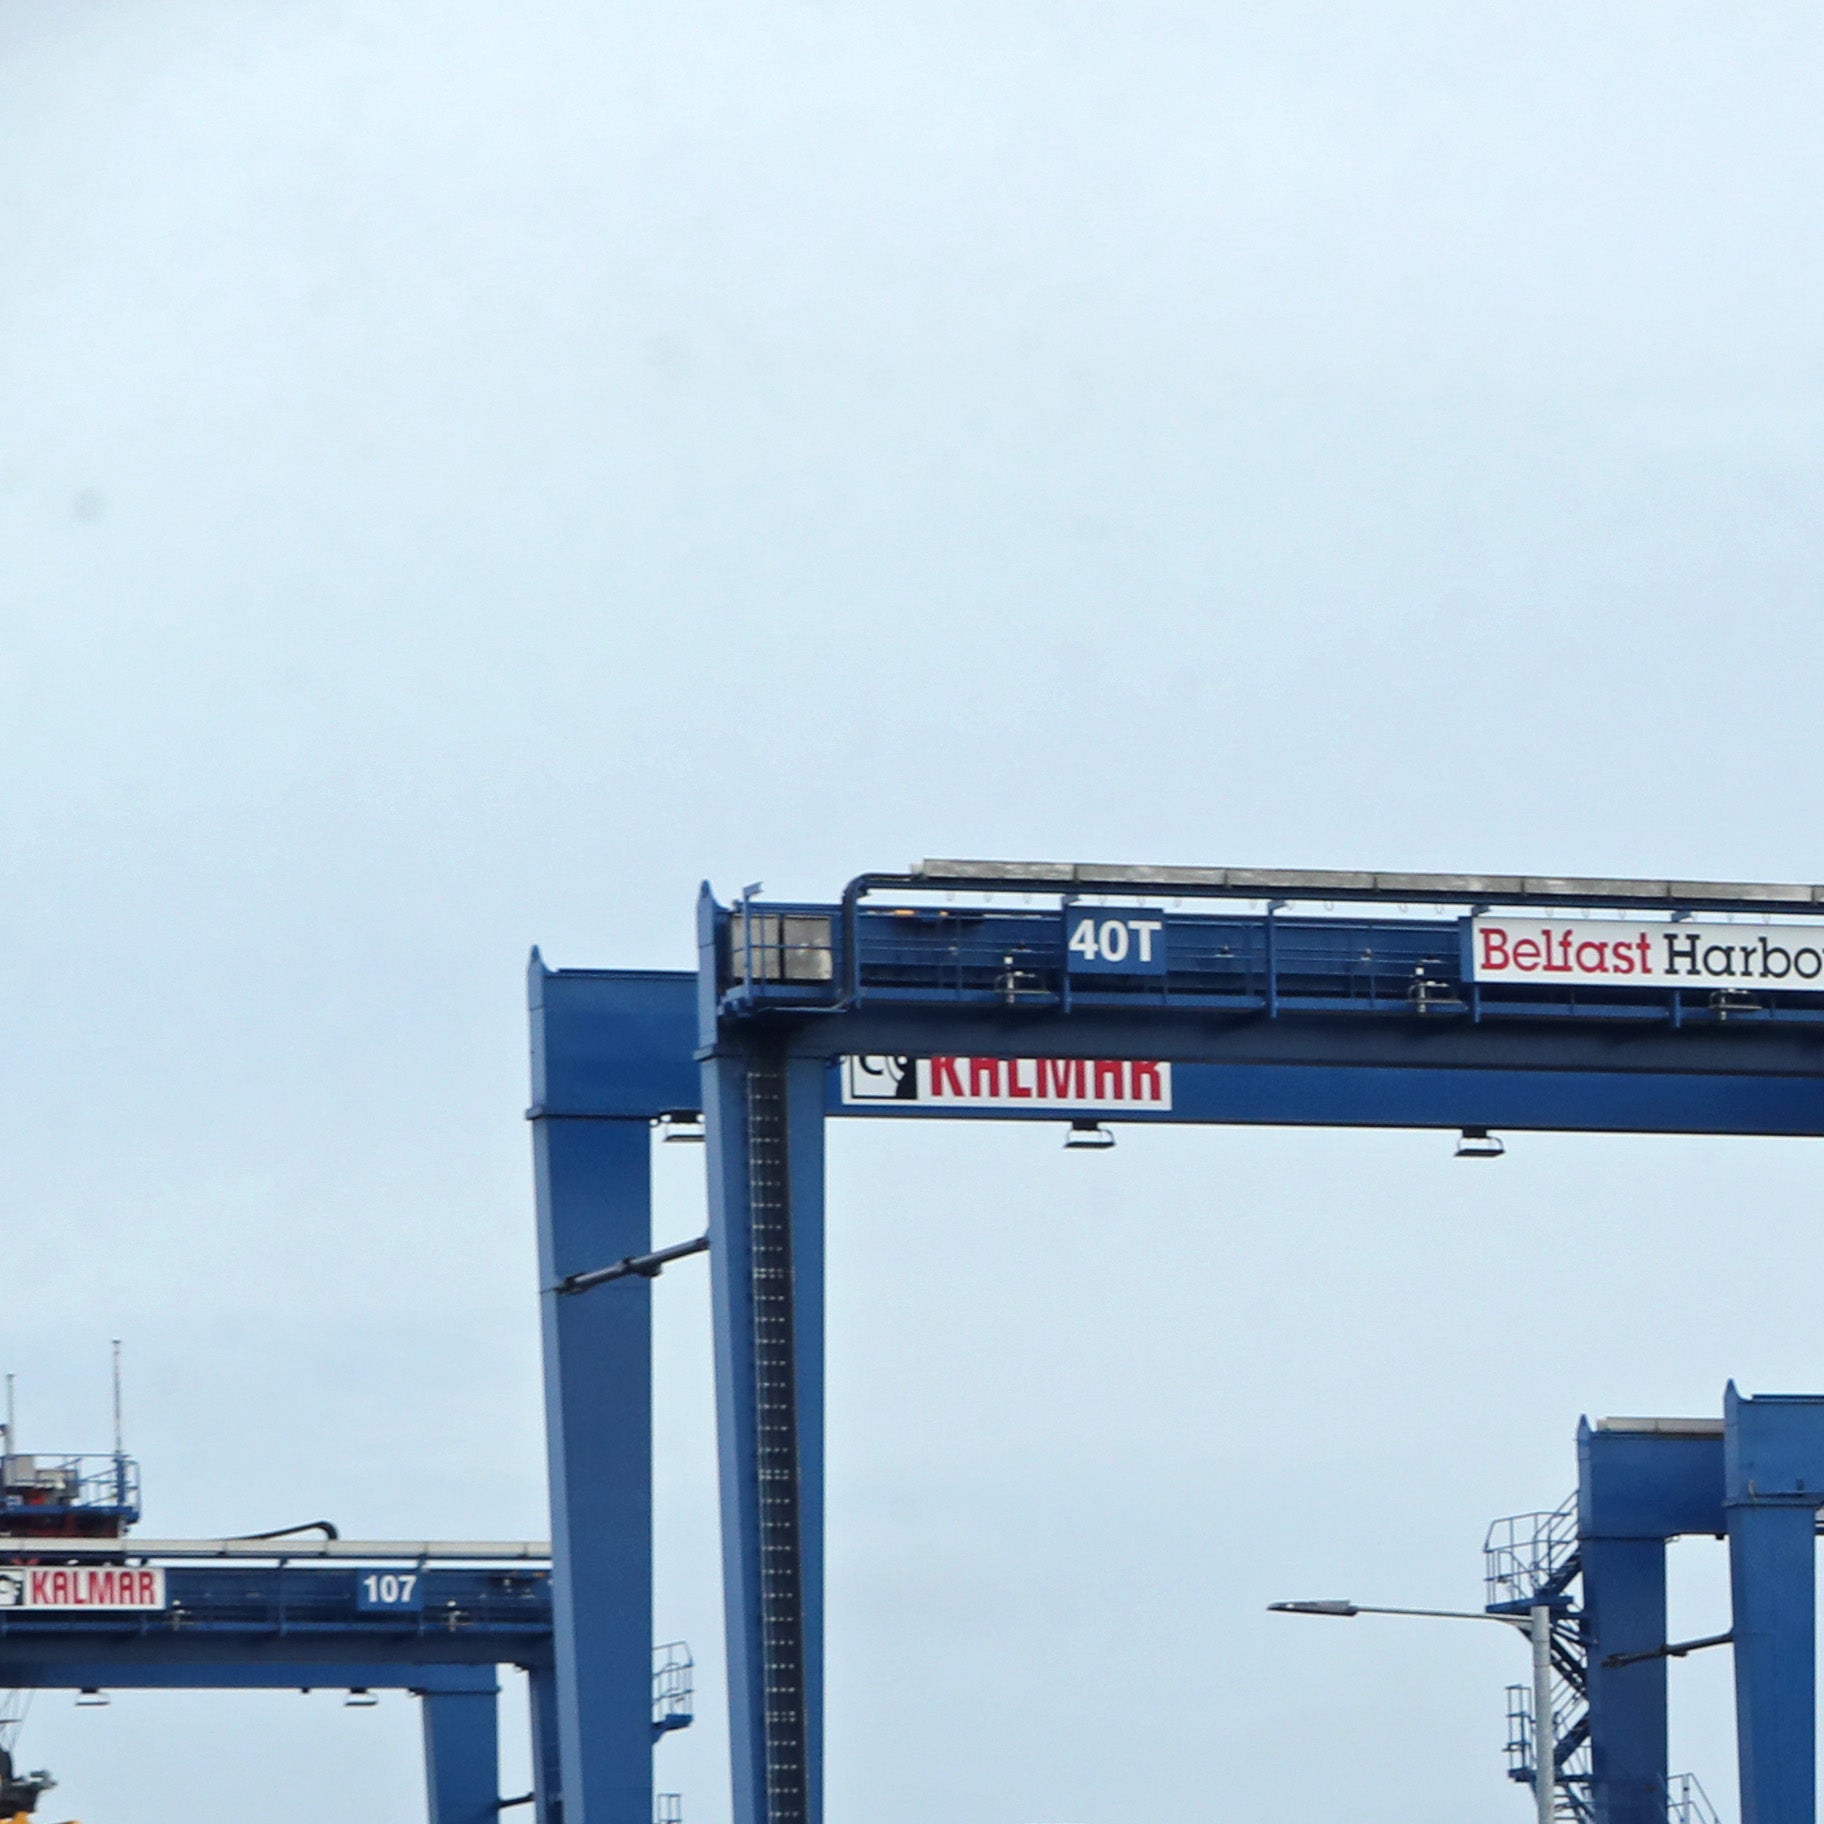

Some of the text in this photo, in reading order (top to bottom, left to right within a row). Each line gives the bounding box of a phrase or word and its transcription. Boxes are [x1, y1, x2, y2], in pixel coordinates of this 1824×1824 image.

[1069, 918, 1162, 963] 40T
[1480, 927, 1653, 976] Belfast
[32, 1570, 155, 1605] KALMAR
[363, 1575, 417, 1603] 107
